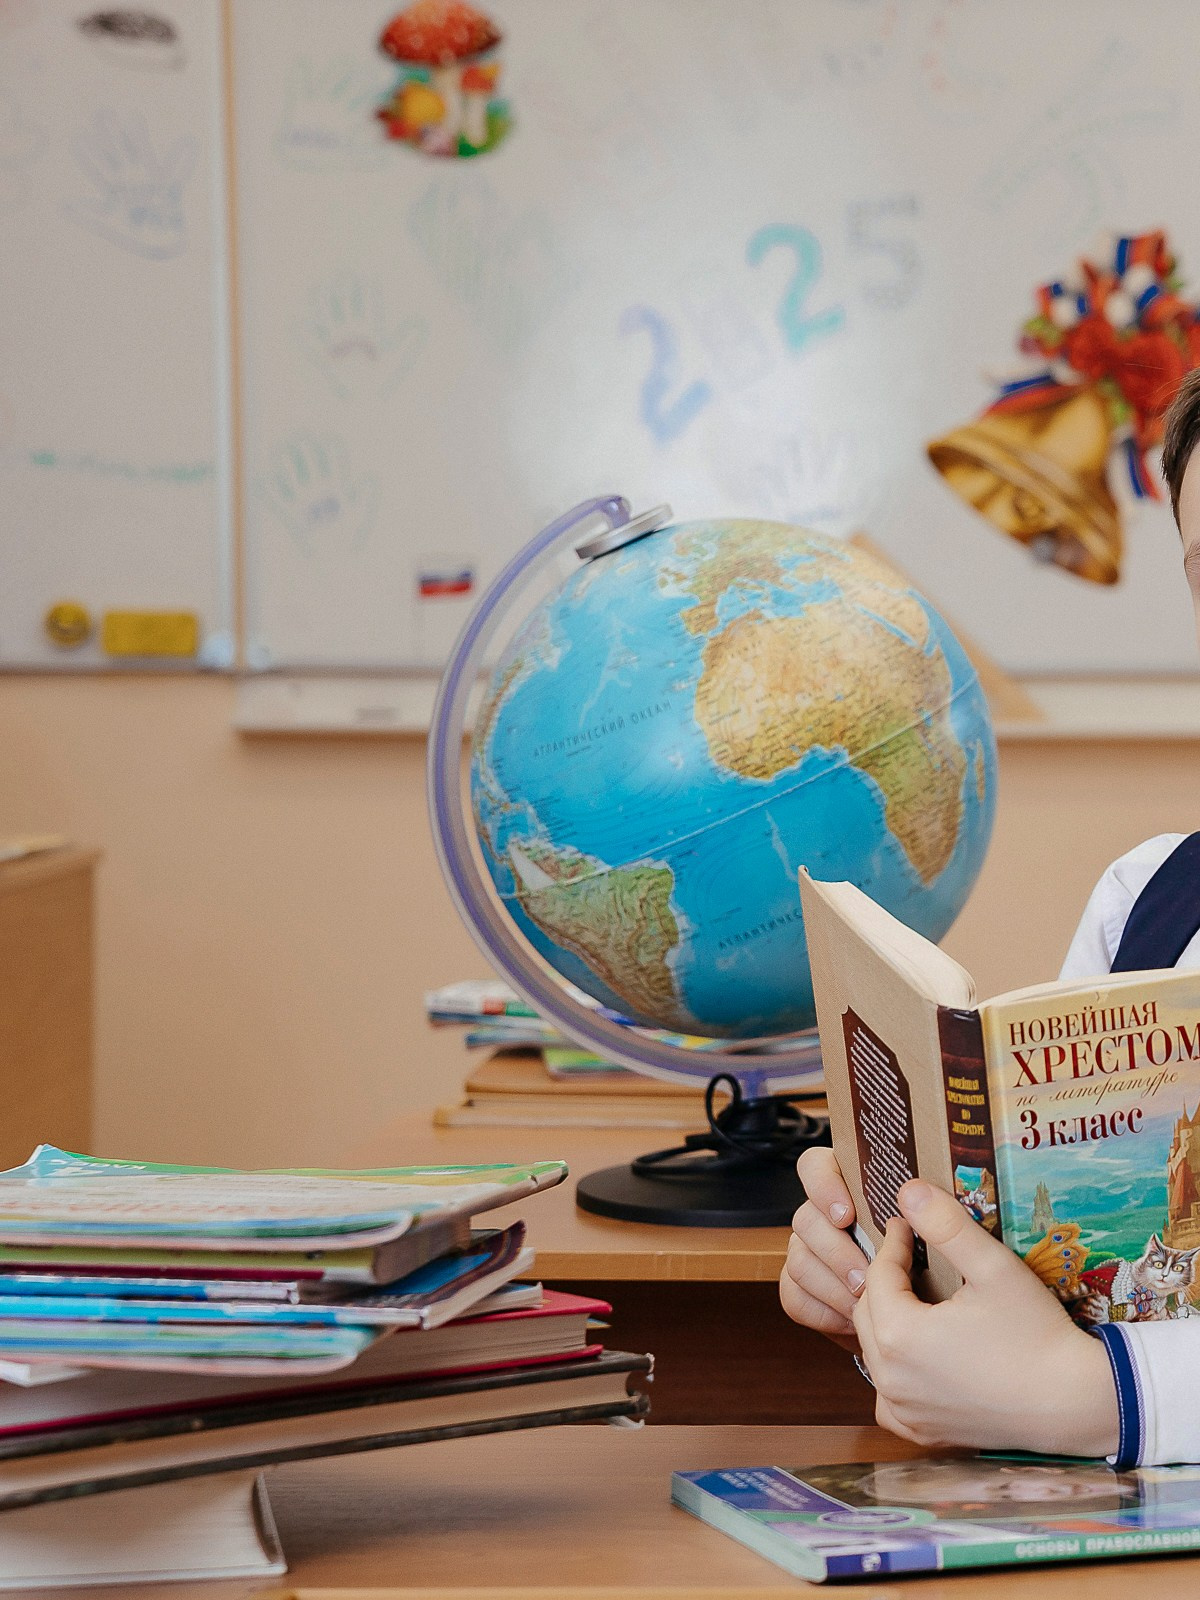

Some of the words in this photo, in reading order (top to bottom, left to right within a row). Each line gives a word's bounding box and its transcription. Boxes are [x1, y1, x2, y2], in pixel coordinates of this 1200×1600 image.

[534, 714, 626, 757] АТЛАНТИЧЕСКИЙ
[631, 700, 672, 724] ОКЕАН
[718, 907, 802, 949] АТЛАНТИЧЕС
[1008, 1000, 1158, 1046] НОВЕЙШАЯ
[1016, 1093, 1038, 1108] по
[1048, 1067, 1179, 1105] литературе
[1020, 1109, 1041, 1150] 3
[1048, 1106, 1144, 1147] класс
[1015, 1538, 1081, 1558] ОСНОВЫ
